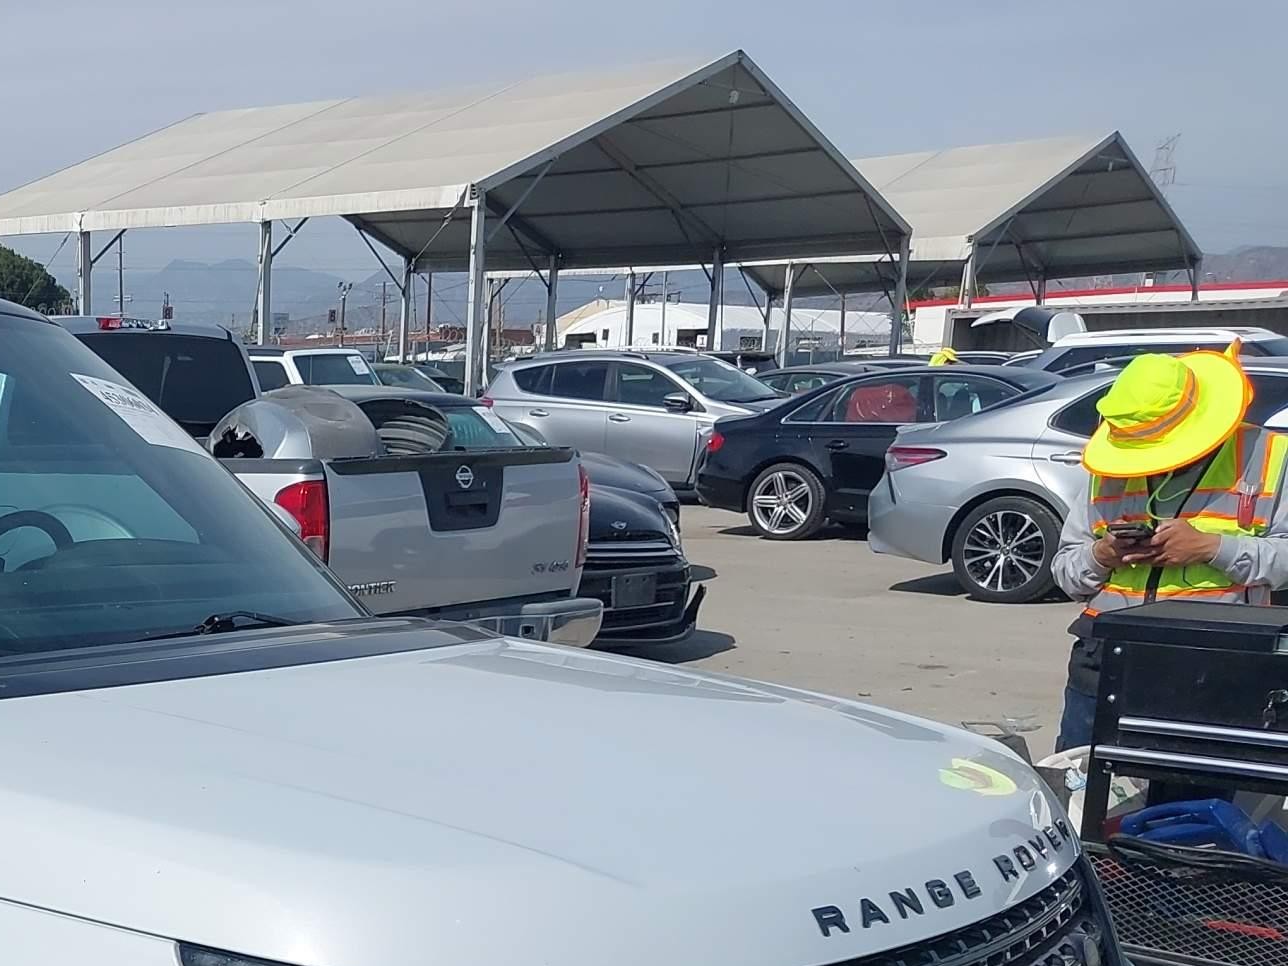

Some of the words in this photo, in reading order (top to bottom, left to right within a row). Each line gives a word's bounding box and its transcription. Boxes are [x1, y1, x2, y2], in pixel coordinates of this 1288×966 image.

[347, 581, 398, 597] ONTIER
[810, 869, 984, 938] RANGE
[992, 816, 1071, 883] ROVER
